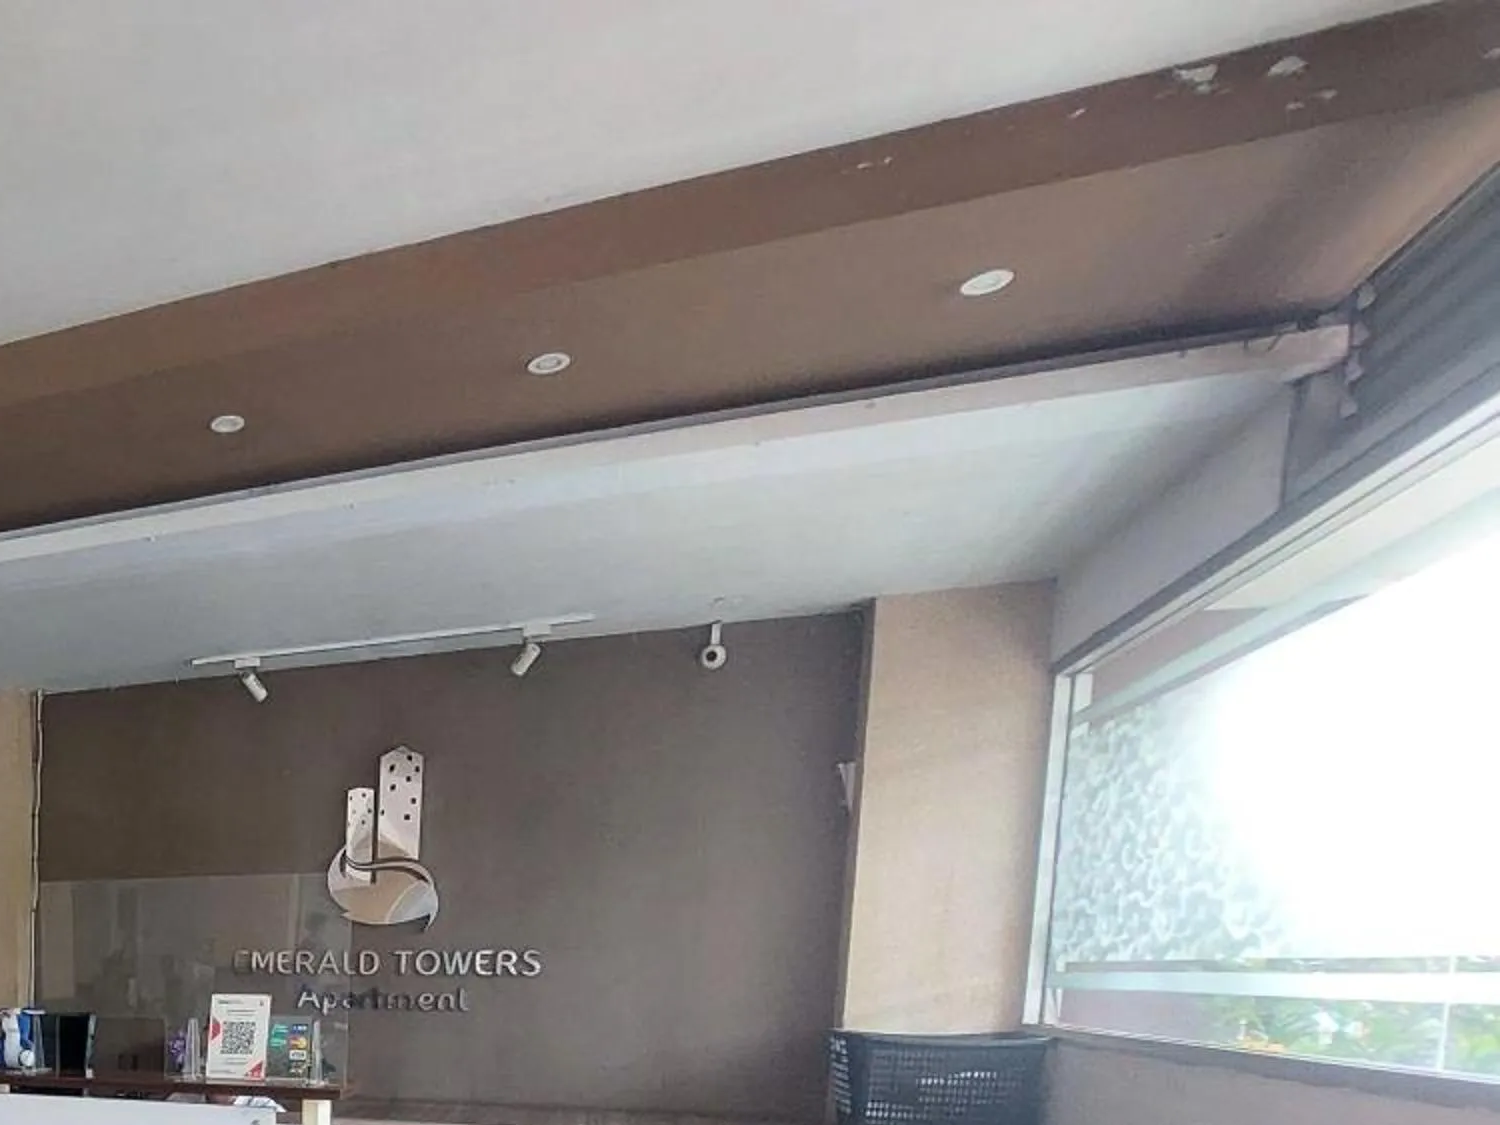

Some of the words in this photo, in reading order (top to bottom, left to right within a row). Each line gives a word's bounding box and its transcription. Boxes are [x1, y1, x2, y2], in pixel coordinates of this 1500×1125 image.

[233, 949, 380, 975] EMERALD
[393, 949, 542, 976] TOWERS
[296, 986, 470, 1016] Apartment
